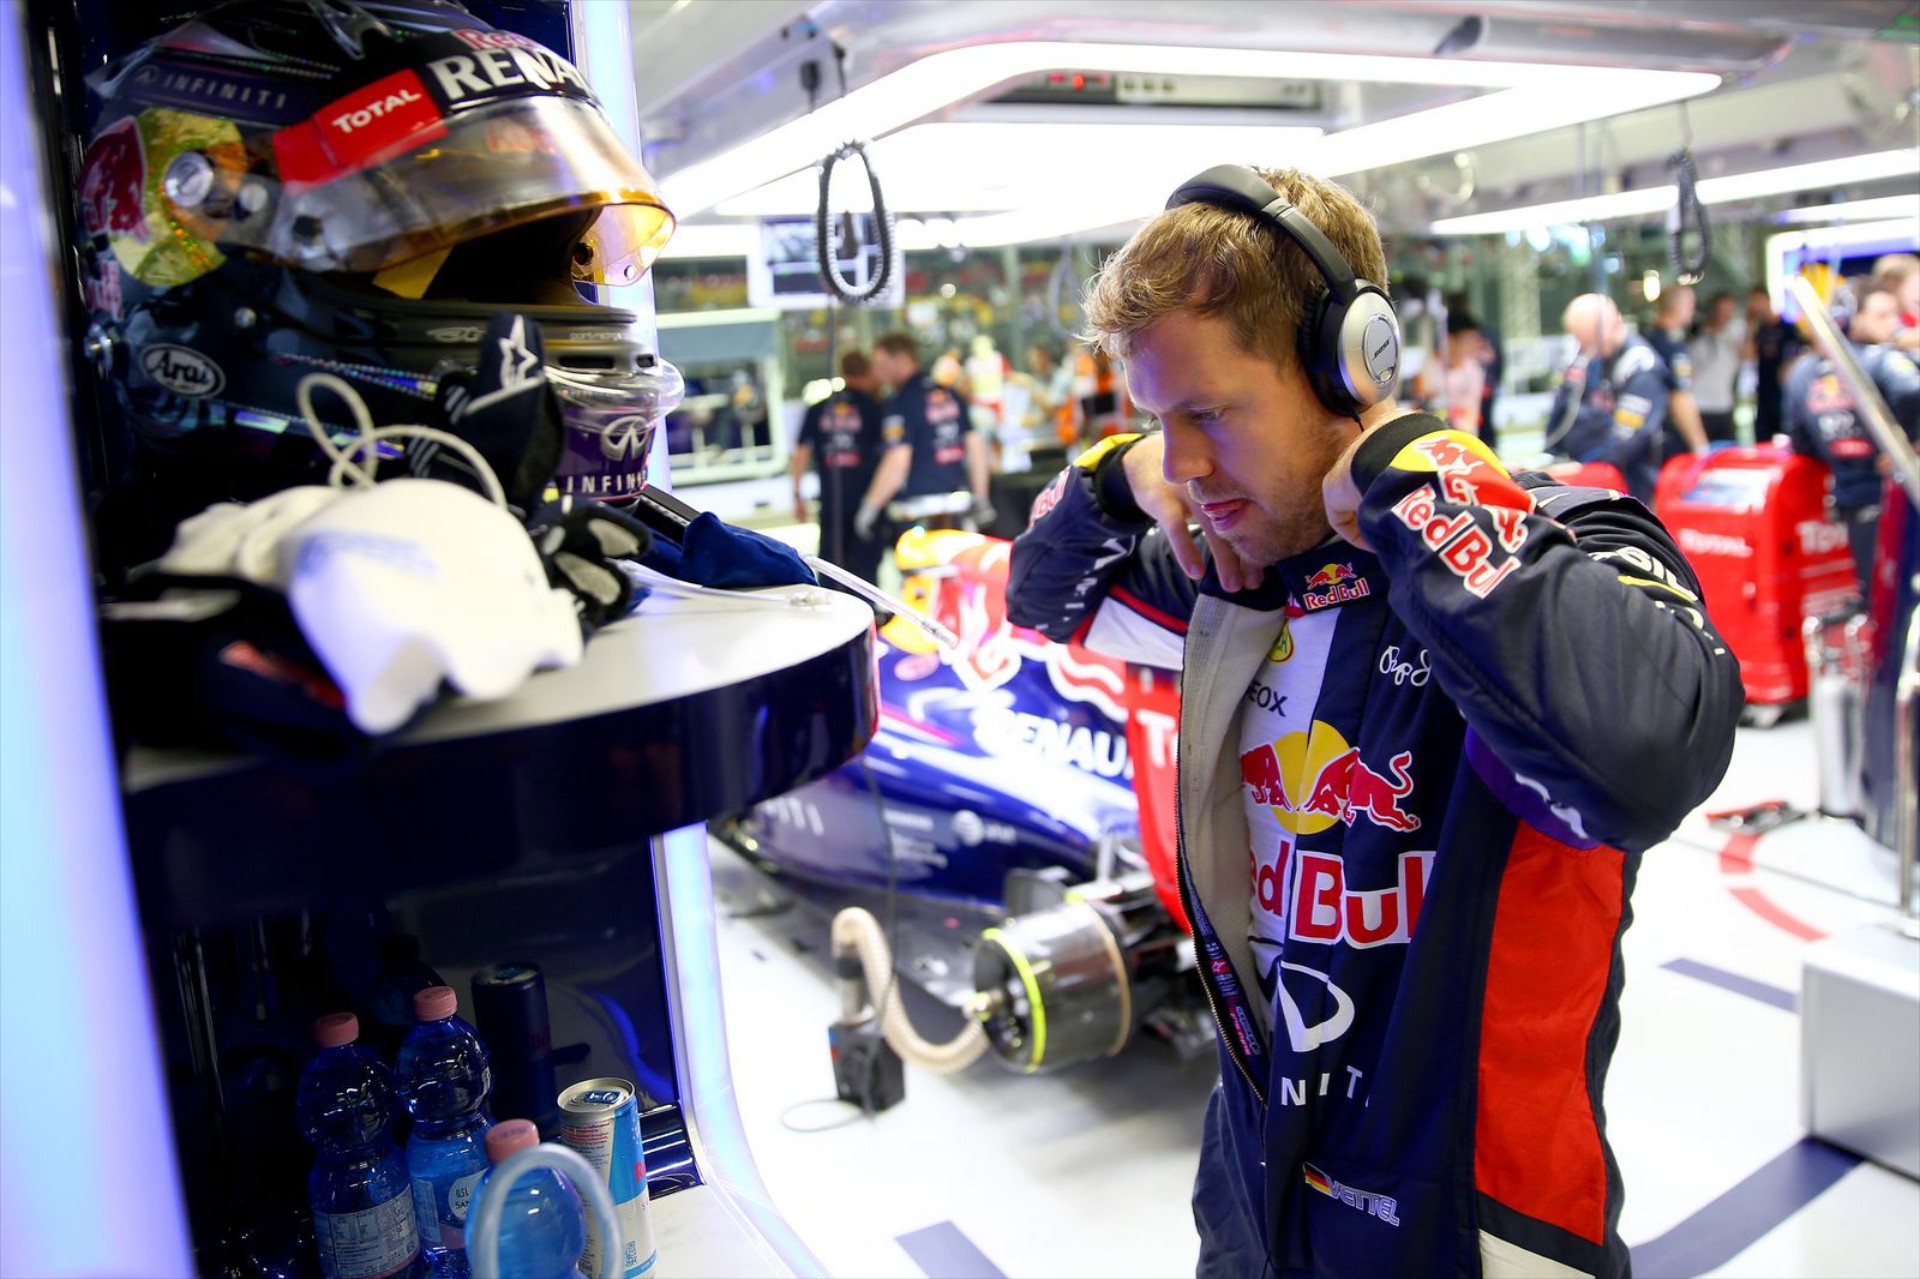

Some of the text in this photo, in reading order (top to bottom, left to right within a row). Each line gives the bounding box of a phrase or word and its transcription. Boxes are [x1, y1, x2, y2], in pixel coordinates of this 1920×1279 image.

[164, 74, 286, 108] INFINITI
[331, 89, 421, 133] TOTAL
[151, 351, 210, 385] Arai
[1391, 482, 1475, 552] Red
[1303, 577, 1370, 610] Red Bull
[1249, 680, 1288, 718] EOX
[1330, 1179, 1400, 1227] VETTEL
